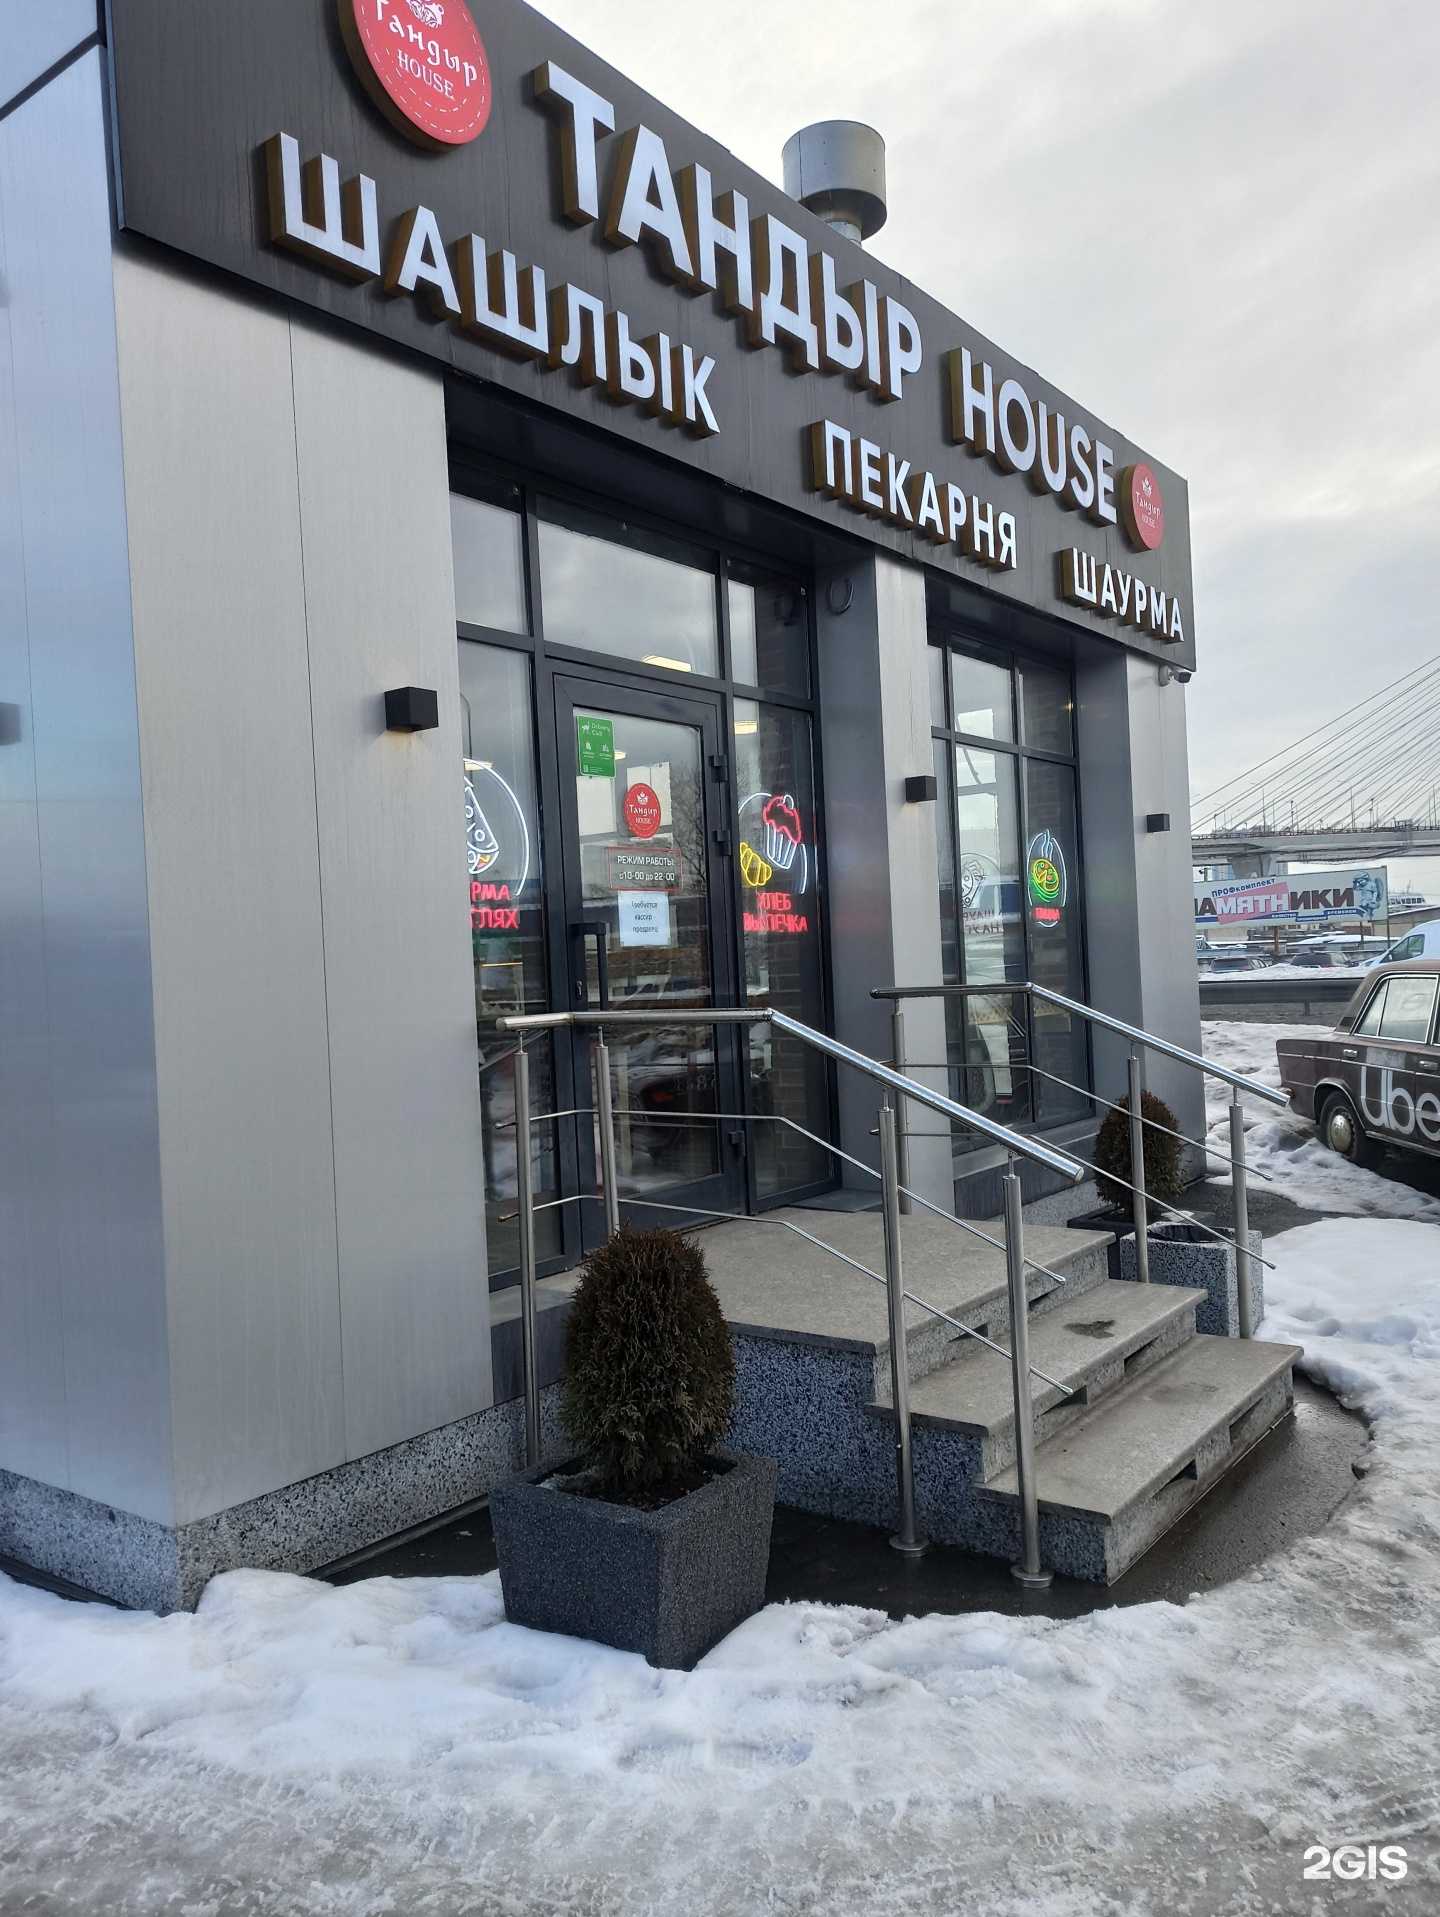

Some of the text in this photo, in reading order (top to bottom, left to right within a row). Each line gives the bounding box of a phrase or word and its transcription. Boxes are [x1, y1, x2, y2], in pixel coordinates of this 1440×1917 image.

[397, 49, 455, 100] HOUSE
[279, 131, 720, 434] ШАШЛЫК
[547, 59, 1117, 524] ТАНДЫР HOUSE
[823, 418, 1018, 569] ПЕКАРНЯ
[1072, 546, 1184, 642] ШАУРМА
[617, 855, 674, 867] РЕЖИМ РАБОТЫ
